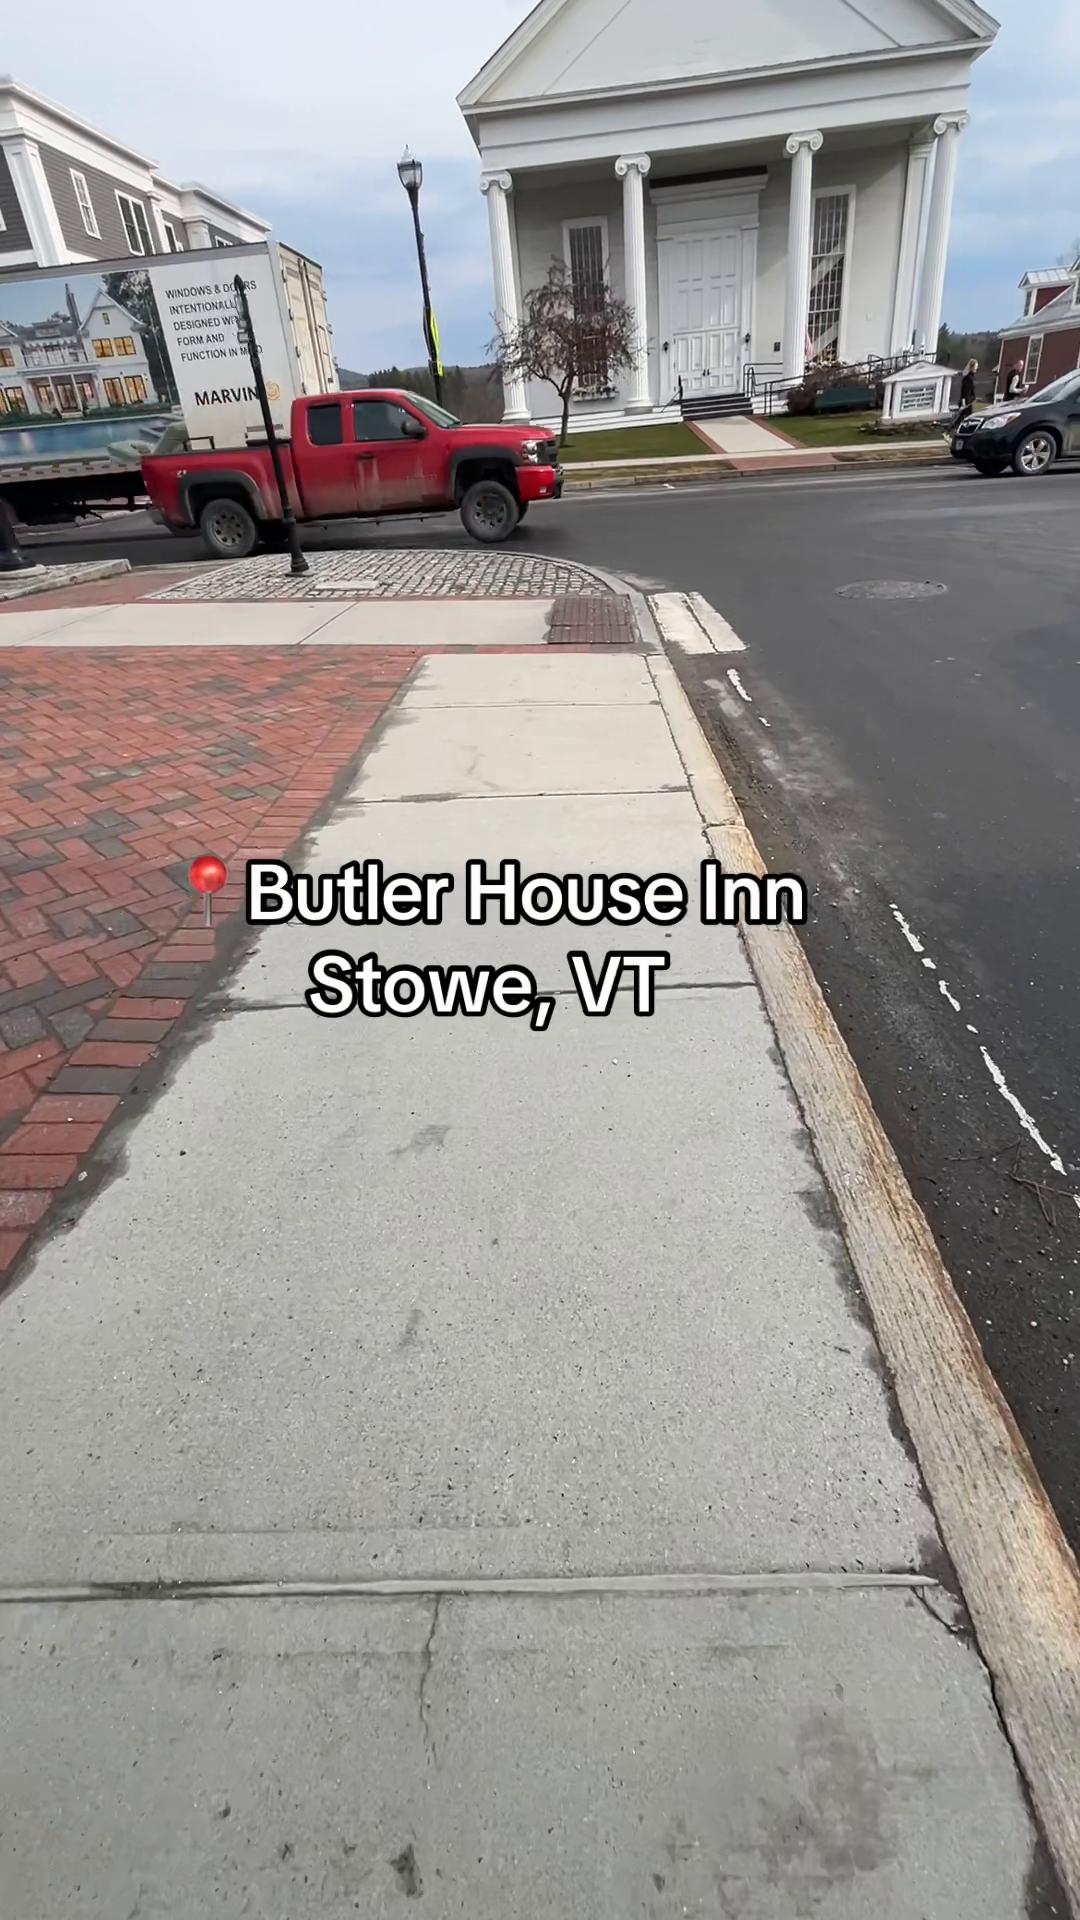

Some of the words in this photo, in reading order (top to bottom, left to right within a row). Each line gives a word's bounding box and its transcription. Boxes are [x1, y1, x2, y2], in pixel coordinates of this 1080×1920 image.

[165, 285, 212, 299] WINDOWS
[214, 284, 221, 294] &
[223, 280, 257, 293] DORS
[169, 299, 240, 315] INTENTIONALL
[173, 317, 221, 331] DESIGNED
[177, 336, 205, 347] FORM
[206, 333, 225, 343] AND
[181, 349, 227, 362] FUNCTION
[228, 347, 238, 358] IN
[240, 345, 264, 356] MD.
[194, 385, 261, 406] MARVIN
